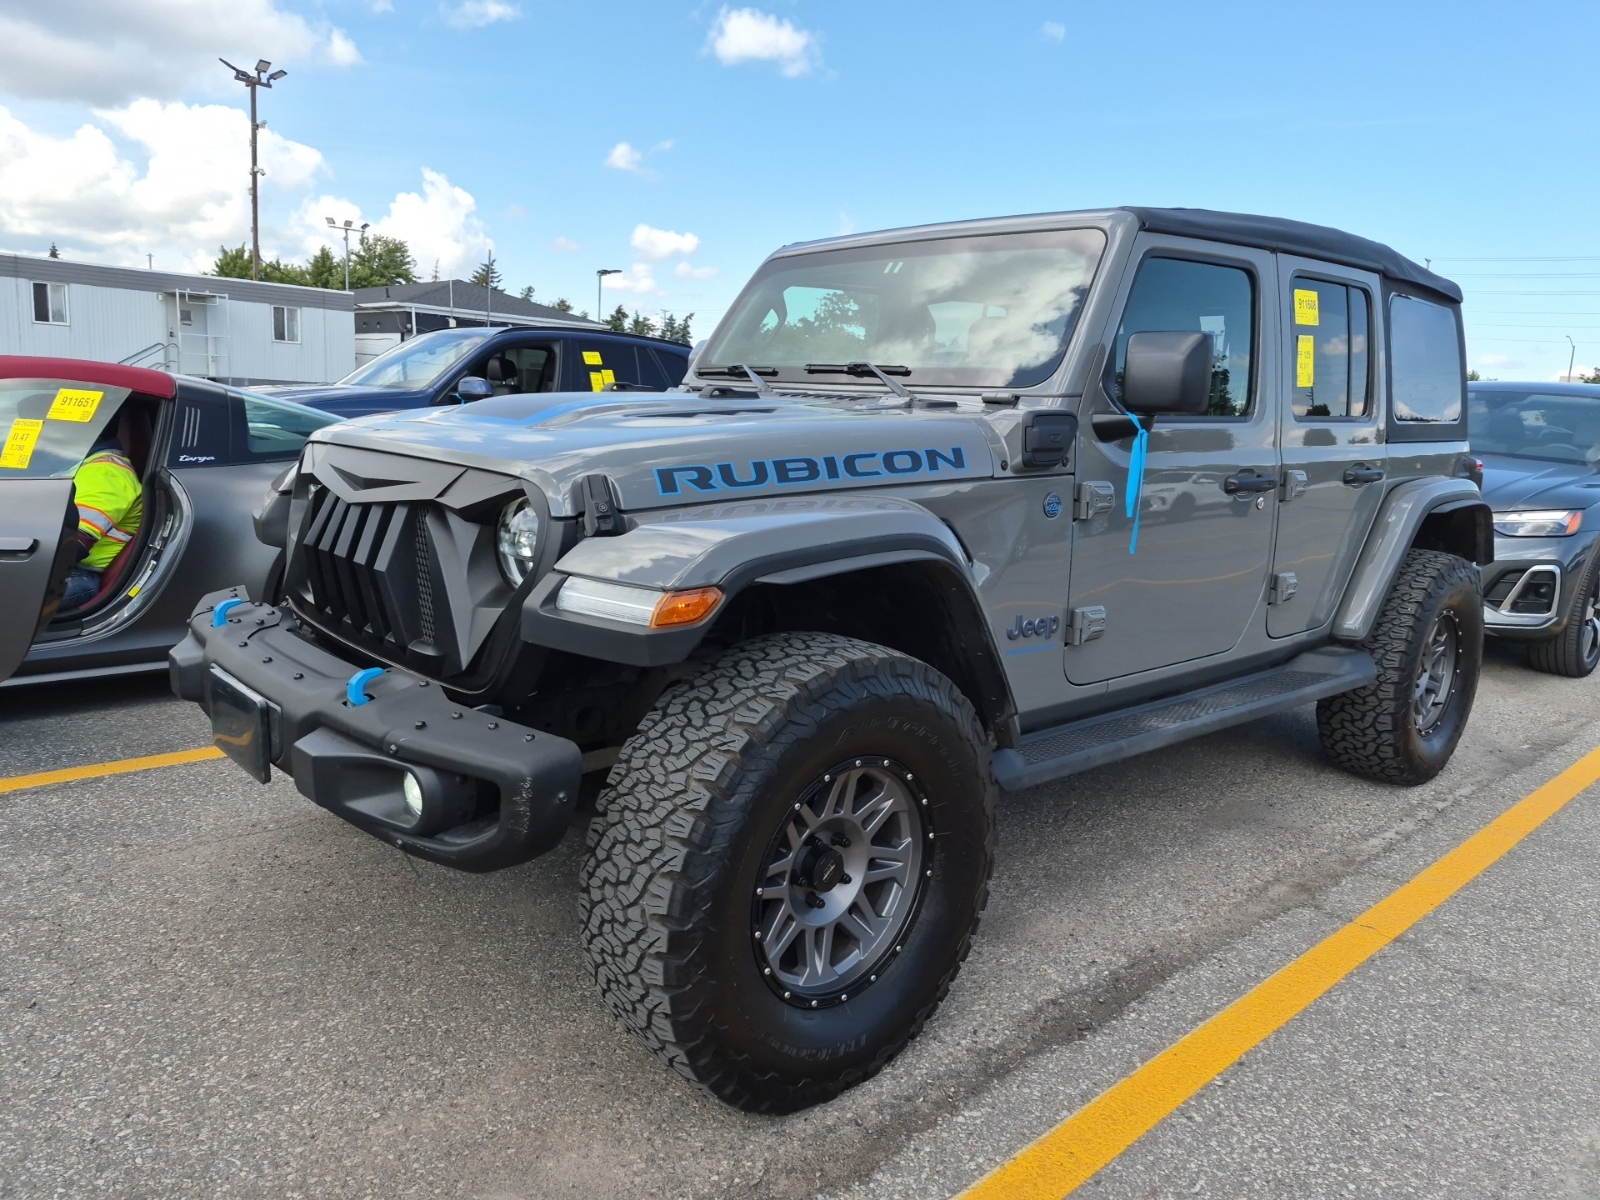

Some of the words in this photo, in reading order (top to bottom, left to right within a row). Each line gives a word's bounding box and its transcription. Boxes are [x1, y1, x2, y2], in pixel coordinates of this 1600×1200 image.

[60, 396, 96, 408] 911651
[179, 454, 216, 463] targa
[653, 446, 966, 496] RUBICON
[1006, 613, 1060, 641] Jeep
